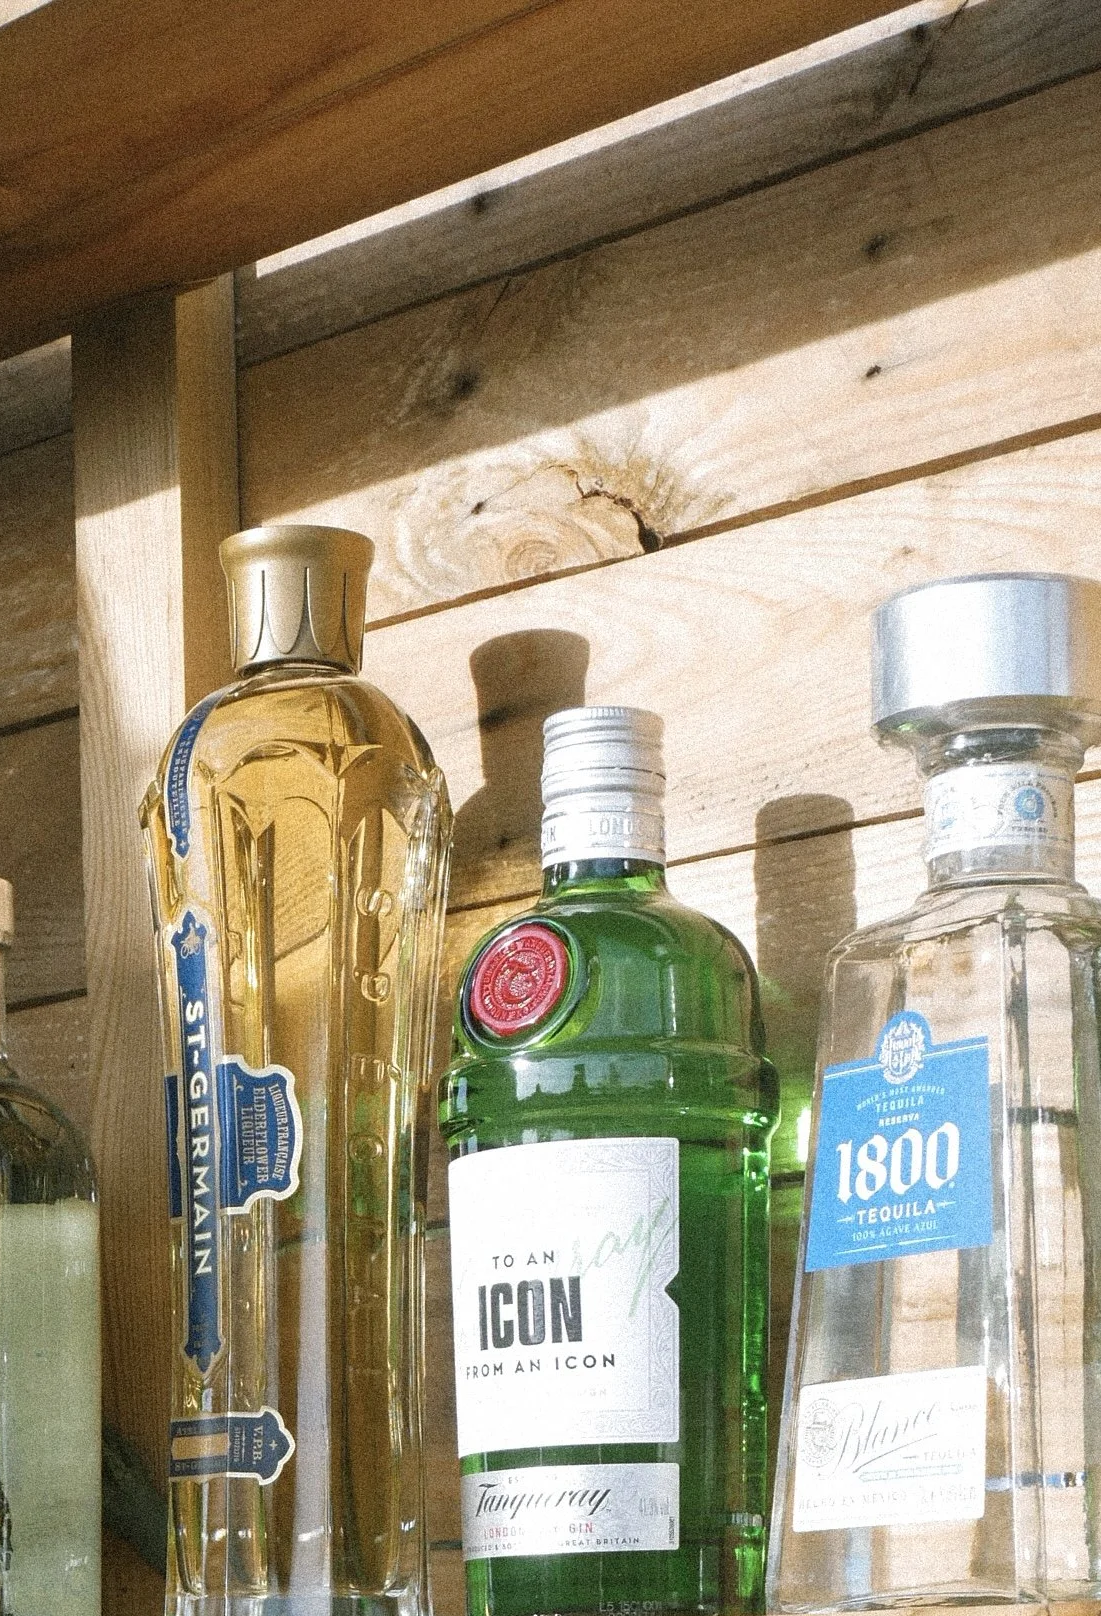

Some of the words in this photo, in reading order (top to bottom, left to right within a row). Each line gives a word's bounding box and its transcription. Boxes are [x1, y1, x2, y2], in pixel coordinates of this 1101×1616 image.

[268, 1083, 287, 1126] LIQUEUR
[875, 1095, 925, 1113] TEQUILA
[879, 1112, 920, 1128] RESERVA
[241, 1107, 254, 1165] LIQUEUR
[253, 1087, 269, 1183] ELDERFLOWER
[271, 1126, 289, 1181] FRANÇAISE
[836, 1121, 960, 1205] 1800
[853, 1230, 876, 1242] 100%
[880, 1224, 910, 1239] AGAVE
[913, 1220, 937, 1233] AZUL
[857, 1199, 936, 1226] TEQUILA
[493, 1254, 515, 1270] TO
[527, 1250, 555, 1267] AN
[478, 1275, 583, 1351] ICON
[466, 1362, 503, 1380] FROM
[515, 1360, 540, 1375] AN
[556, 1354, 616, 1371] ICON
[252, 1425, 264, 1465] V.P.B.
[832, 1399, 939, 1478] Blanco
[475, 1483, 612, 1520] Tanqueray
[569, 1521, 594, 1535] GIN
[596, 1536, 640, 1547] BRITAIN
